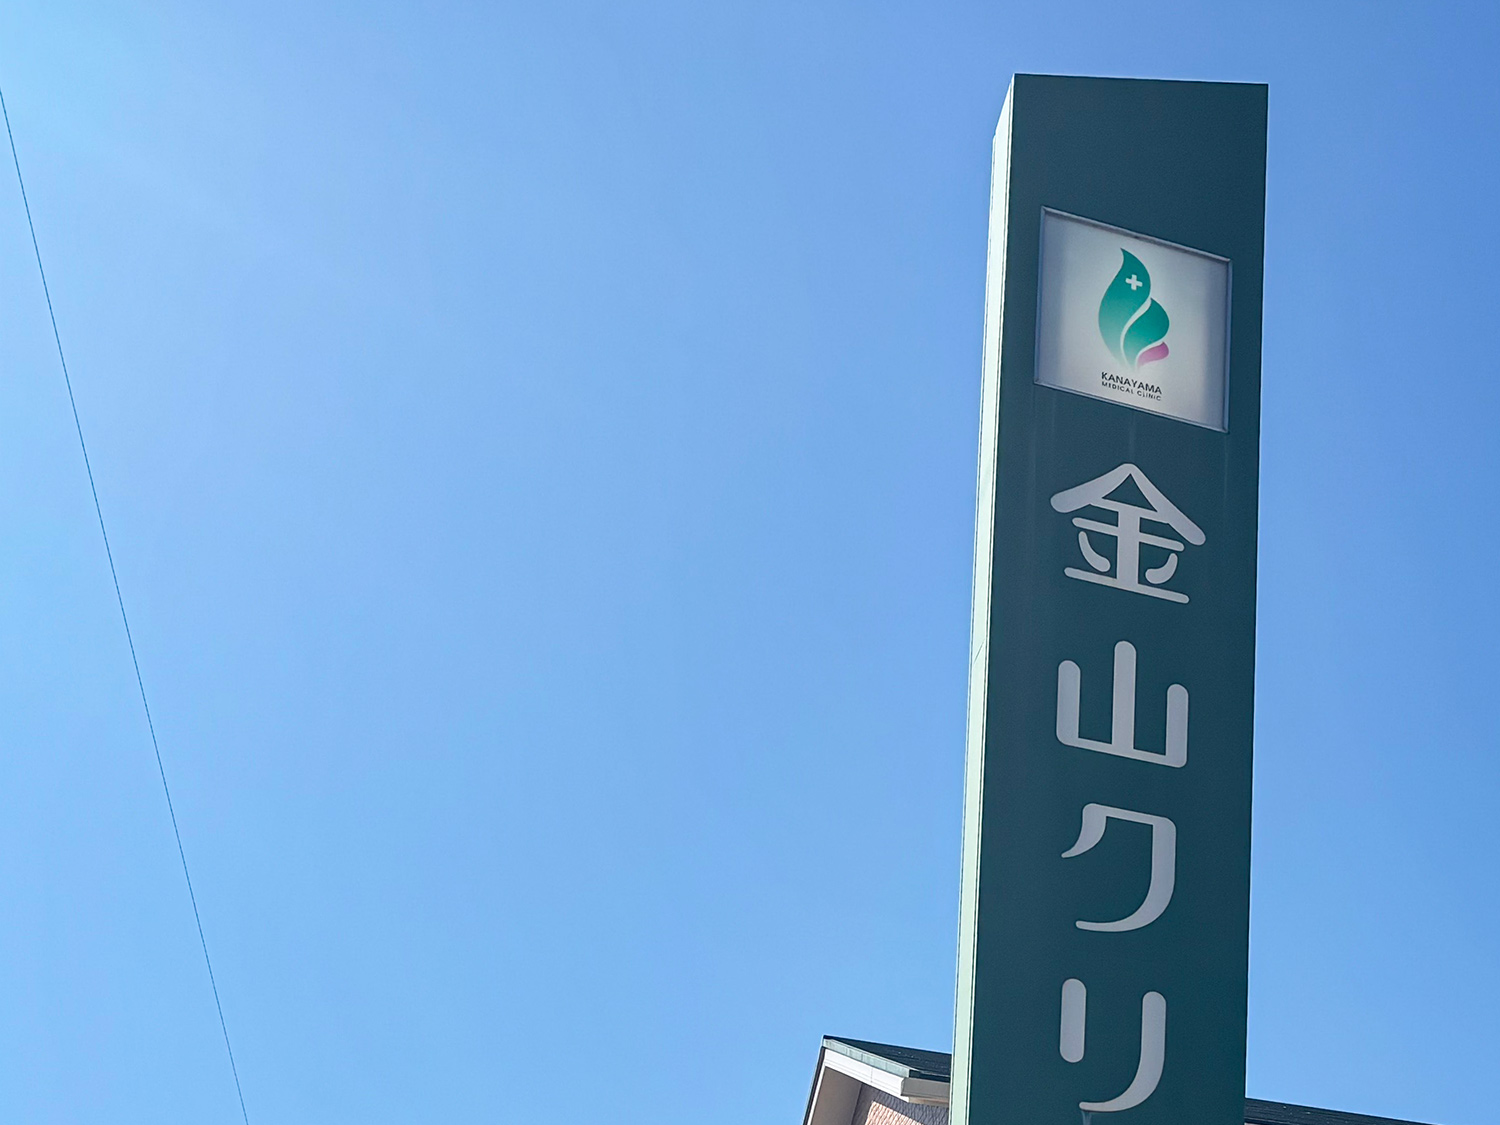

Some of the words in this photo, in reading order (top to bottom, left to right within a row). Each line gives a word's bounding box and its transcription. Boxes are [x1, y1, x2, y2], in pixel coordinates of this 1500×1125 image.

[1101, 371, 1162, 395] KANAYAMA
[1101, 381, 1134, 395] MEDICAL
[1136, 390, 1162, 401] CLINIC
